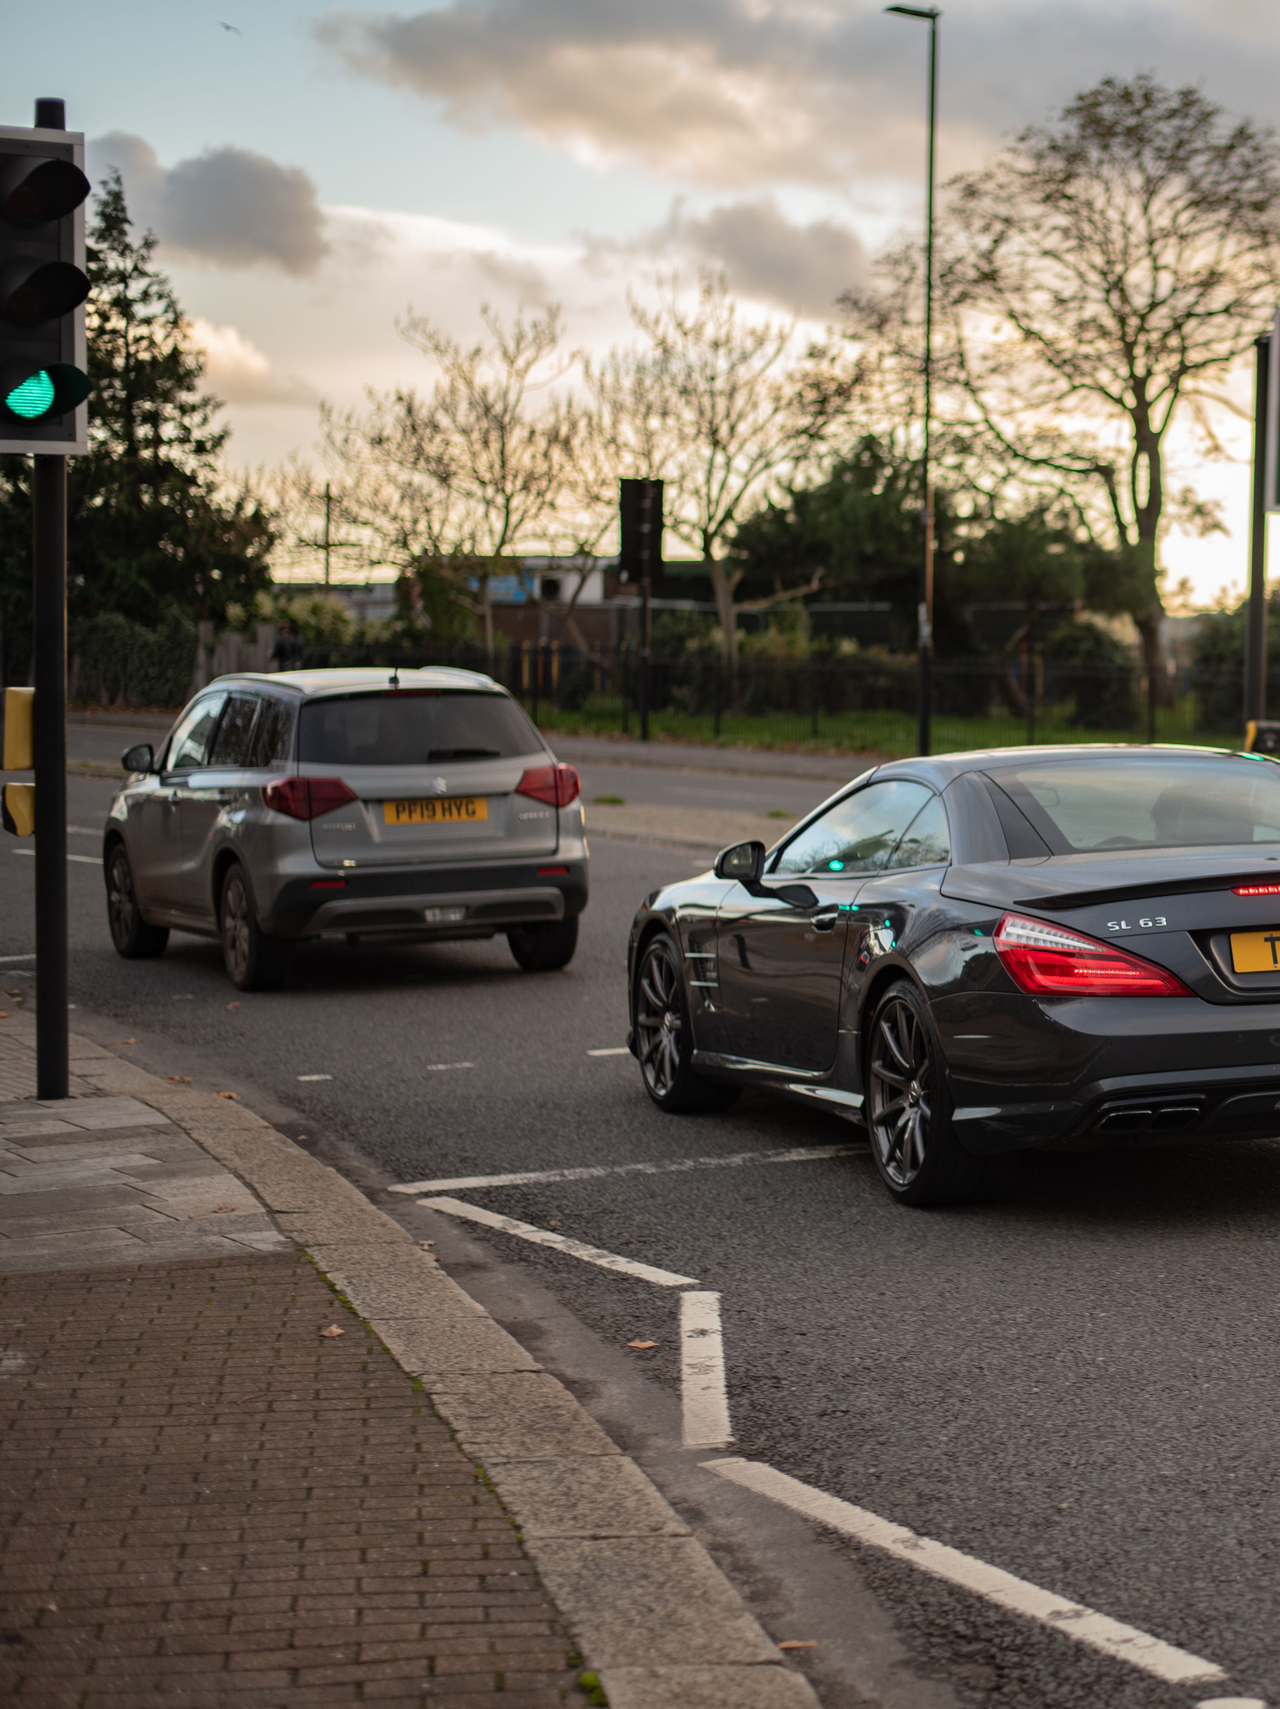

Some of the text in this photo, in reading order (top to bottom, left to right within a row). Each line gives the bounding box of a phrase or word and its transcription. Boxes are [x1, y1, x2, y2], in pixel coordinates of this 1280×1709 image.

[395, 799, 477, 822] PF19 HYG
[1107, 916, 1167, 932] SL 63
